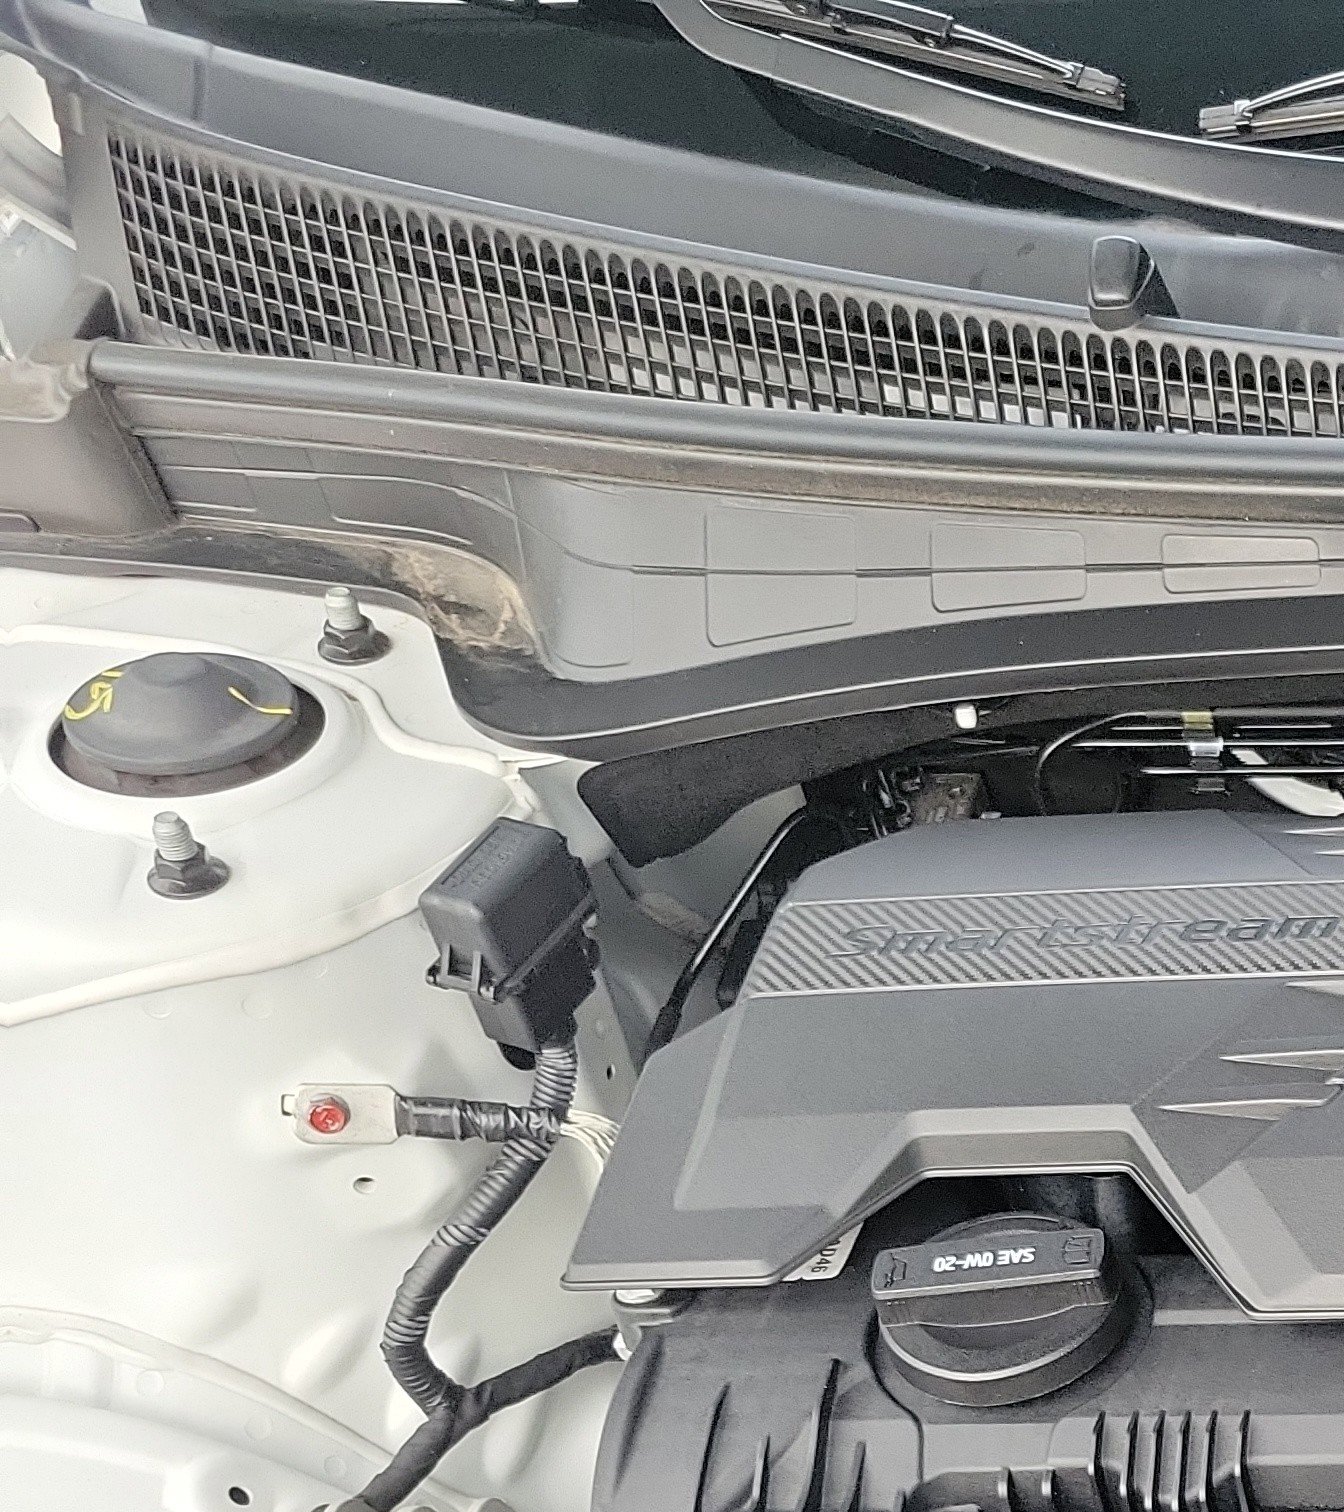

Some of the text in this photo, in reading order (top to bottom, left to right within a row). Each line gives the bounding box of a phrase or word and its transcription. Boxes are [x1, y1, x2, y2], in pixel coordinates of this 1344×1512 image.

[824, 914, 1340, 957] Smartstream
[932, 1247, 1036, 1273] SAE 0W-20
